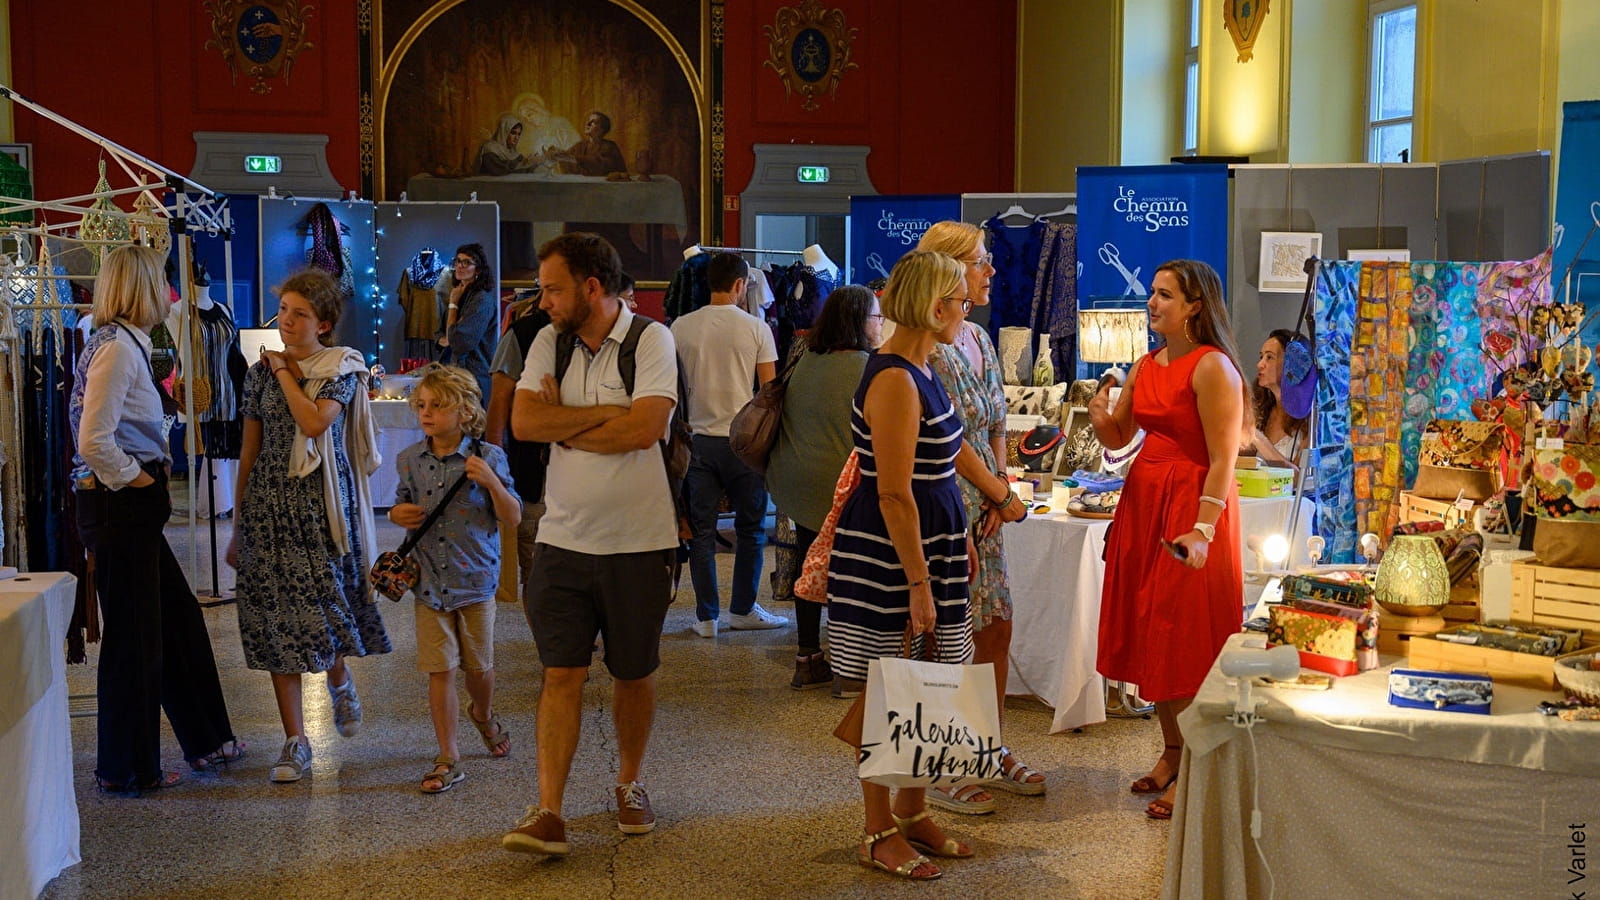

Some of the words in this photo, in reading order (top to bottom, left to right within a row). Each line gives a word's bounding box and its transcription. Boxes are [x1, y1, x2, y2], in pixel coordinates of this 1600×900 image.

[1119, 185, 1136, 198] Le
[1113, 197, 1188, 213] Chemin
[881, 209, 895, 219] Le
[877, 218, 932, 230] Chemin
[1126, 212, 1144, 222] des
[1145, 211, 1189, 232] Sens
[886, 230, 900, 238] des
[888, 702, 975, 754] Galeries
